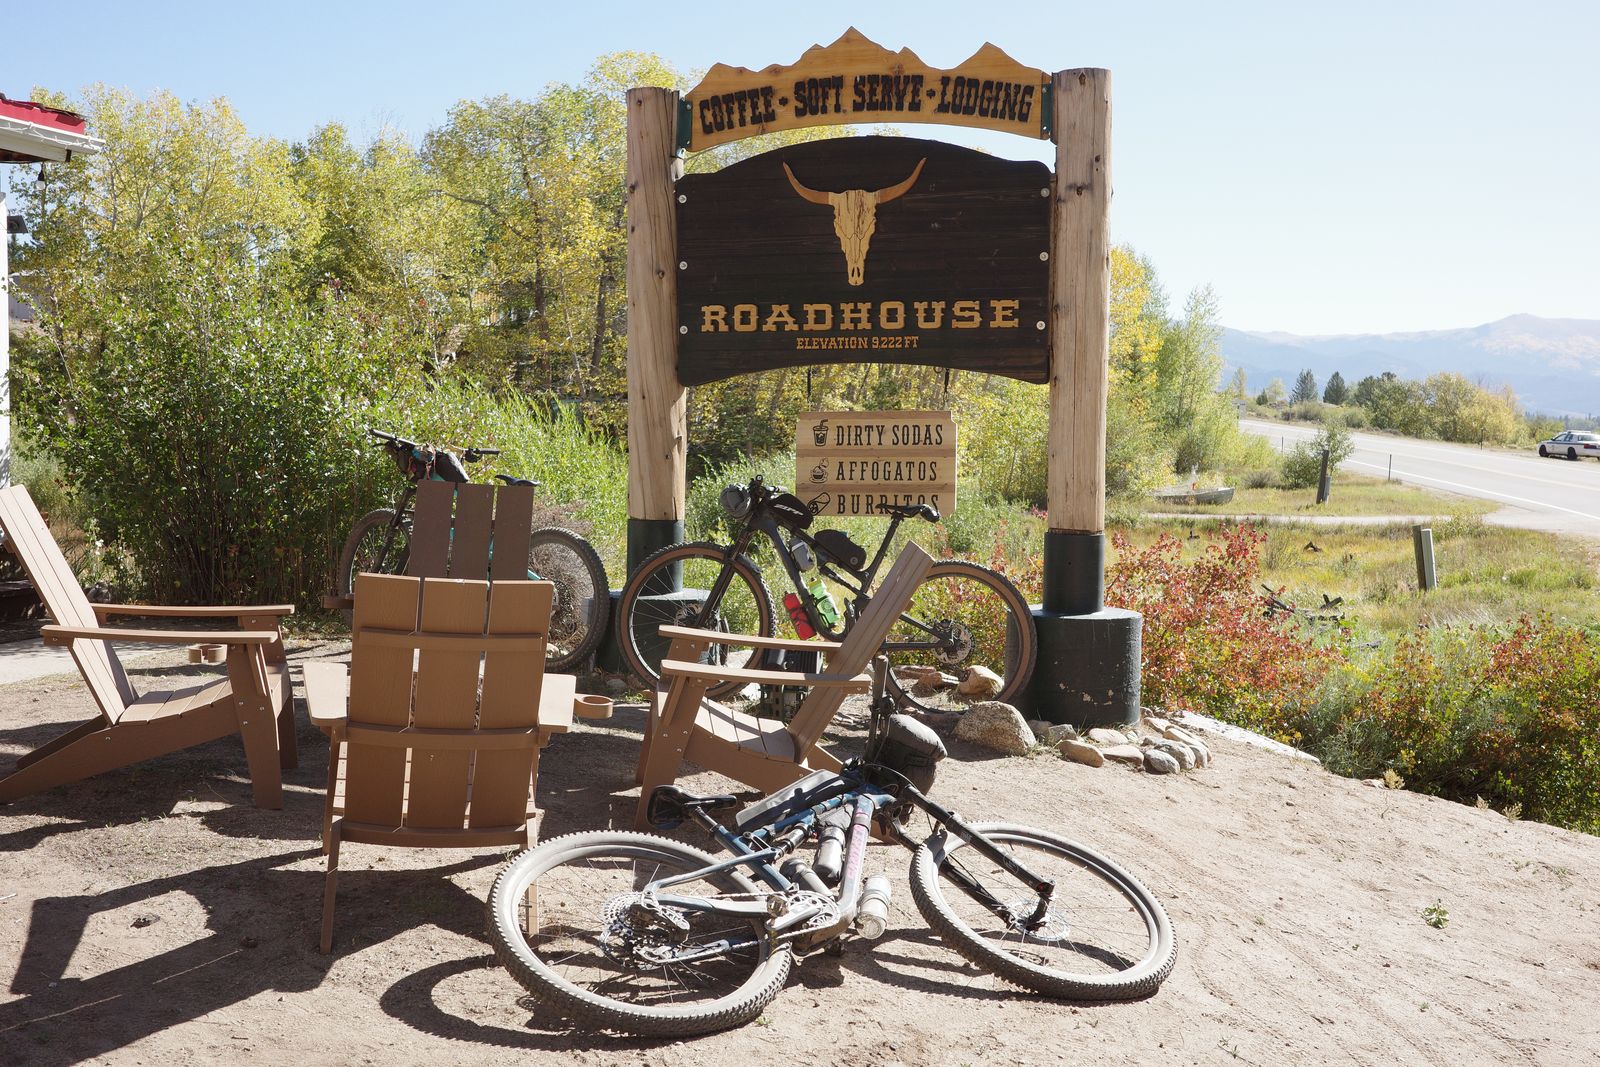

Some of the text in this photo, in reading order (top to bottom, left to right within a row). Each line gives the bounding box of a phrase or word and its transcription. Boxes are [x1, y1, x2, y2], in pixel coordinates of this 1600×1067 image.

[700, 74, 1035, 134] COFFEE SOFT SERVE LODGING
[701, 300, 1020, 333] ROADHOUSE
[796, 337, 868, 350] ELEVATION
[904, 336, 919, 348] FT
[836, 424, 943, 446] DIRTY SODAS
[836, 461, 937, 481] AFFOGATOS
